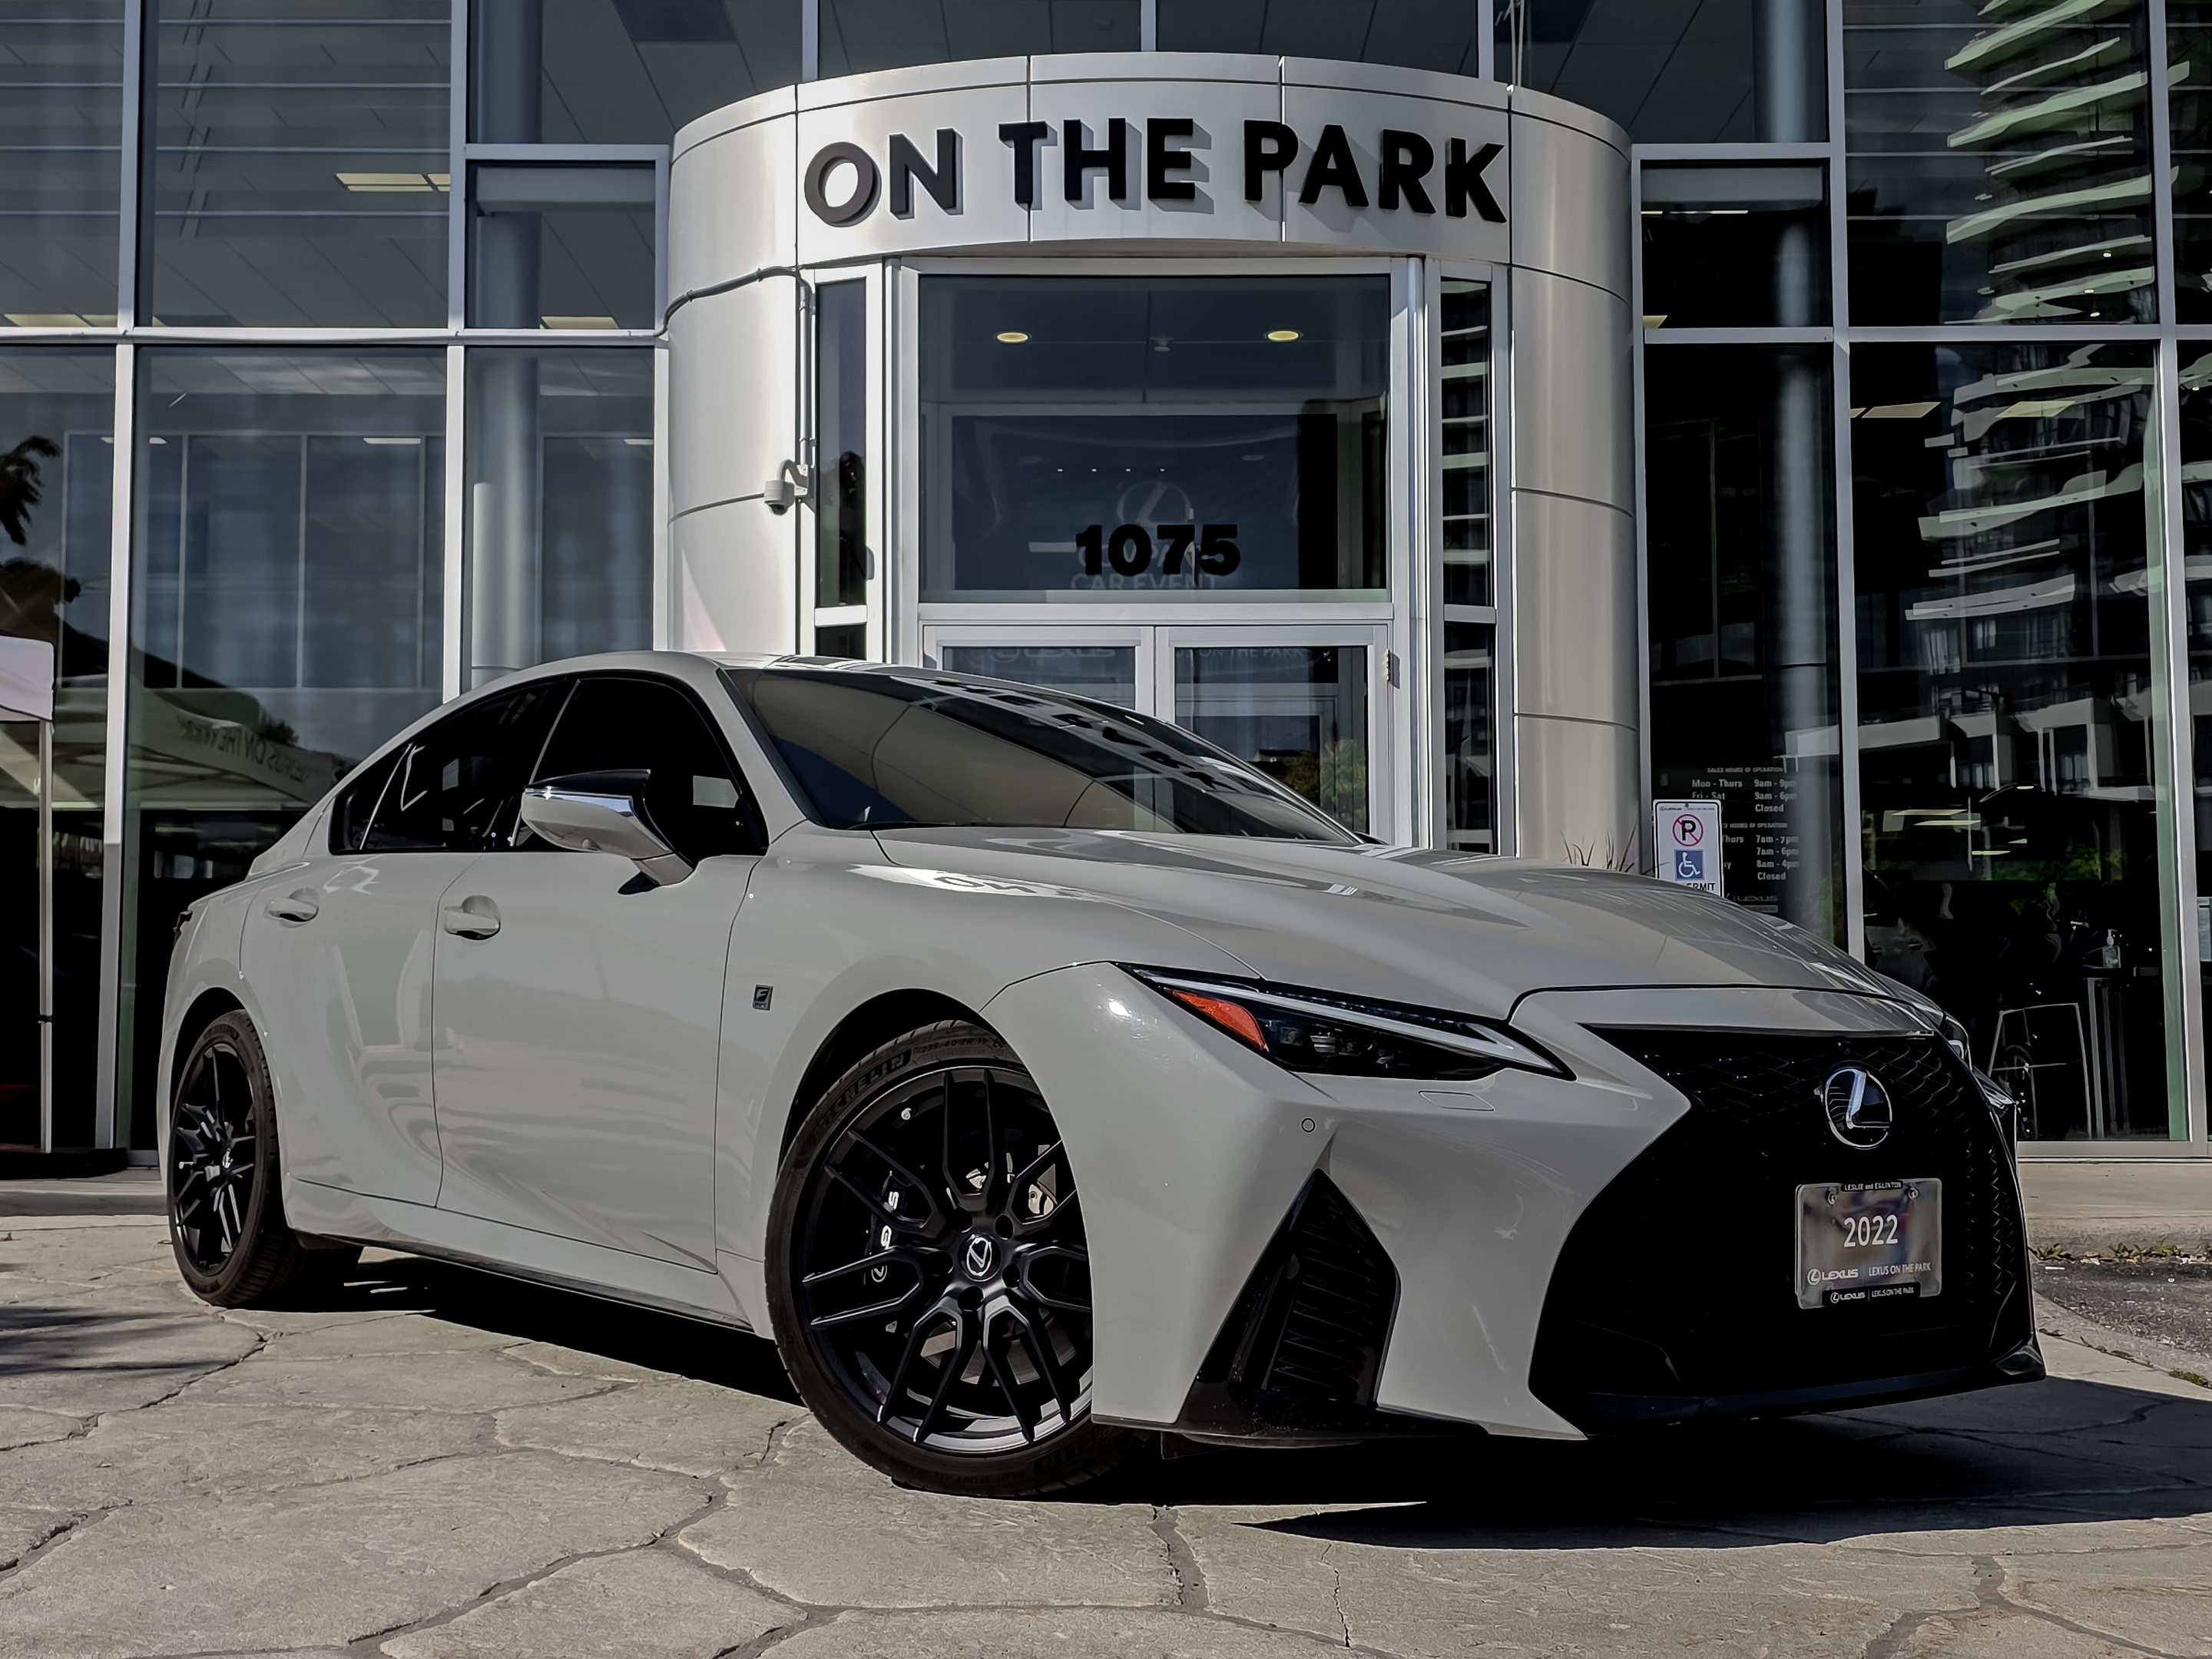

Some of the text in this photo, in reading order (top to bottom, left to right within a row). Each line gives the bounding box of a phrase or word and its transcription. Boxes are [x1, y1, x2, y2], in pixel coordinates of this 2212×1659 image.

[804, 117, 1507, 227] ON THE PARK
[1075, 524, 1241, 576] 1075
[1692, 779, 1711, 787] Mon
[1718, 779, 1743, 787] Thurs
[1753, 779, 1772, 787] 9am
[1780, 779, 1797, 790] 9pm
[1711, 791, 1725, 800] Sat
[1754, 791, 1773, 800] 9am
[1780, 791, 1797, 802] 6pm
[1755, 803, 1784, 813] Closed
[1756, 834, 1773, 843] 7am
[1756, 847, 1774, 856] 7am
[1781, 847, 1800, 858] 6pm
[1757, 859, 1774, 868] 8am
[1782, 859, 1800, 870] 4pm
[1757, 872, 1786, 880] Closed
[1843, 1214, 1899, 1248] 2022
[1822, 1262, 1932, 1280] LEXUS LEXUS ON THE PARK
[1839, 1292, 1866, 1300] LEXUS
